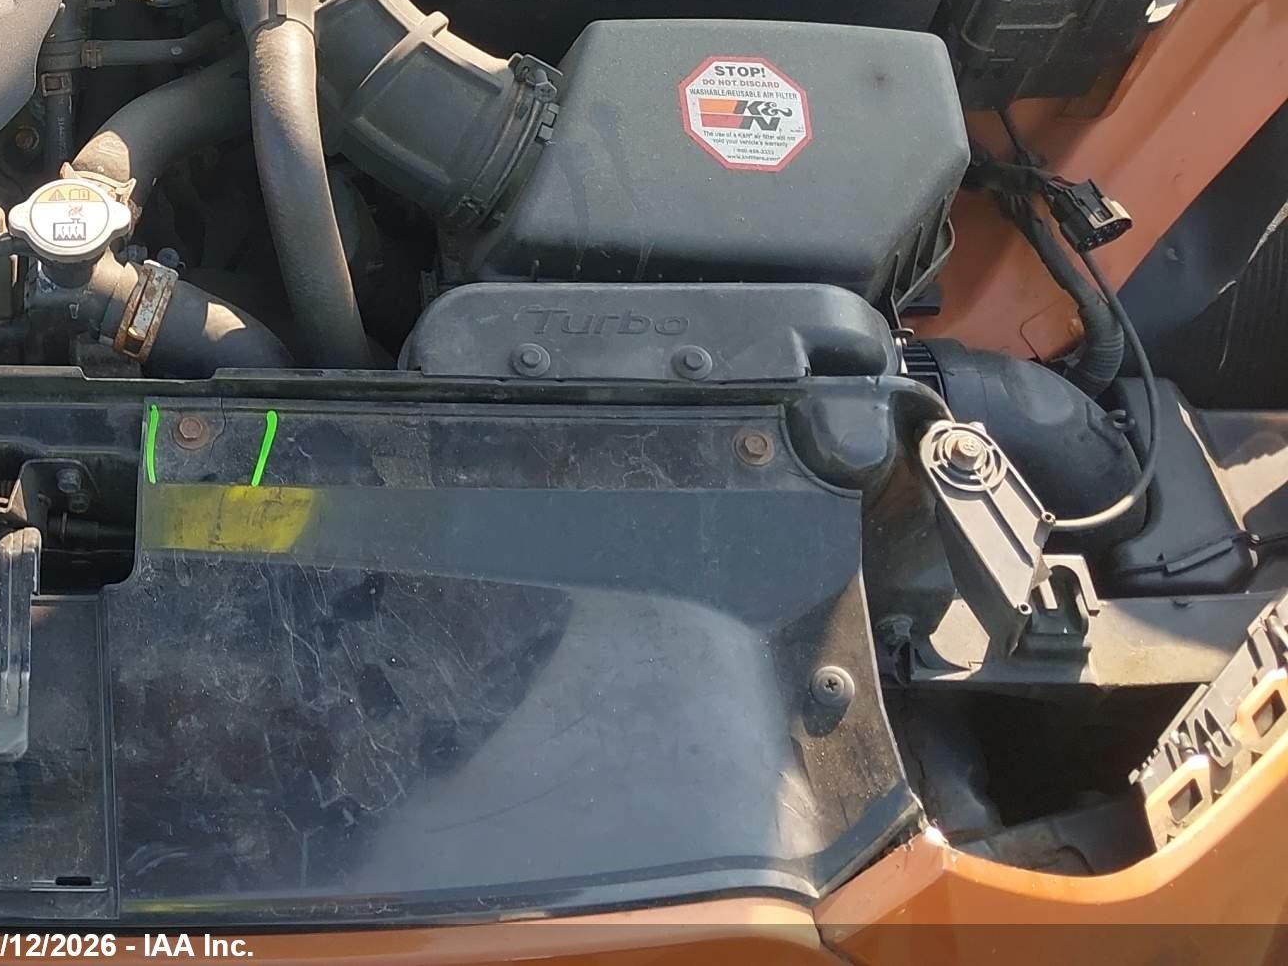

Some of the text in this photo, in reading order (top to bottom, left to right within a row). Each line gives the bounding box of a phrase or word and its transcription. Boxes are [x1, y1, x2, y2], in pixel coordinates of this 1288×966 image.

[714, 65, 766, 78] STOP!
[702, 78, 780, 89] DO NOT DISCARD
[689, 88, 797, 100] WASHABLE/REUSABLE AIR FILTER
[525, 306, 690, 336] Turbo
